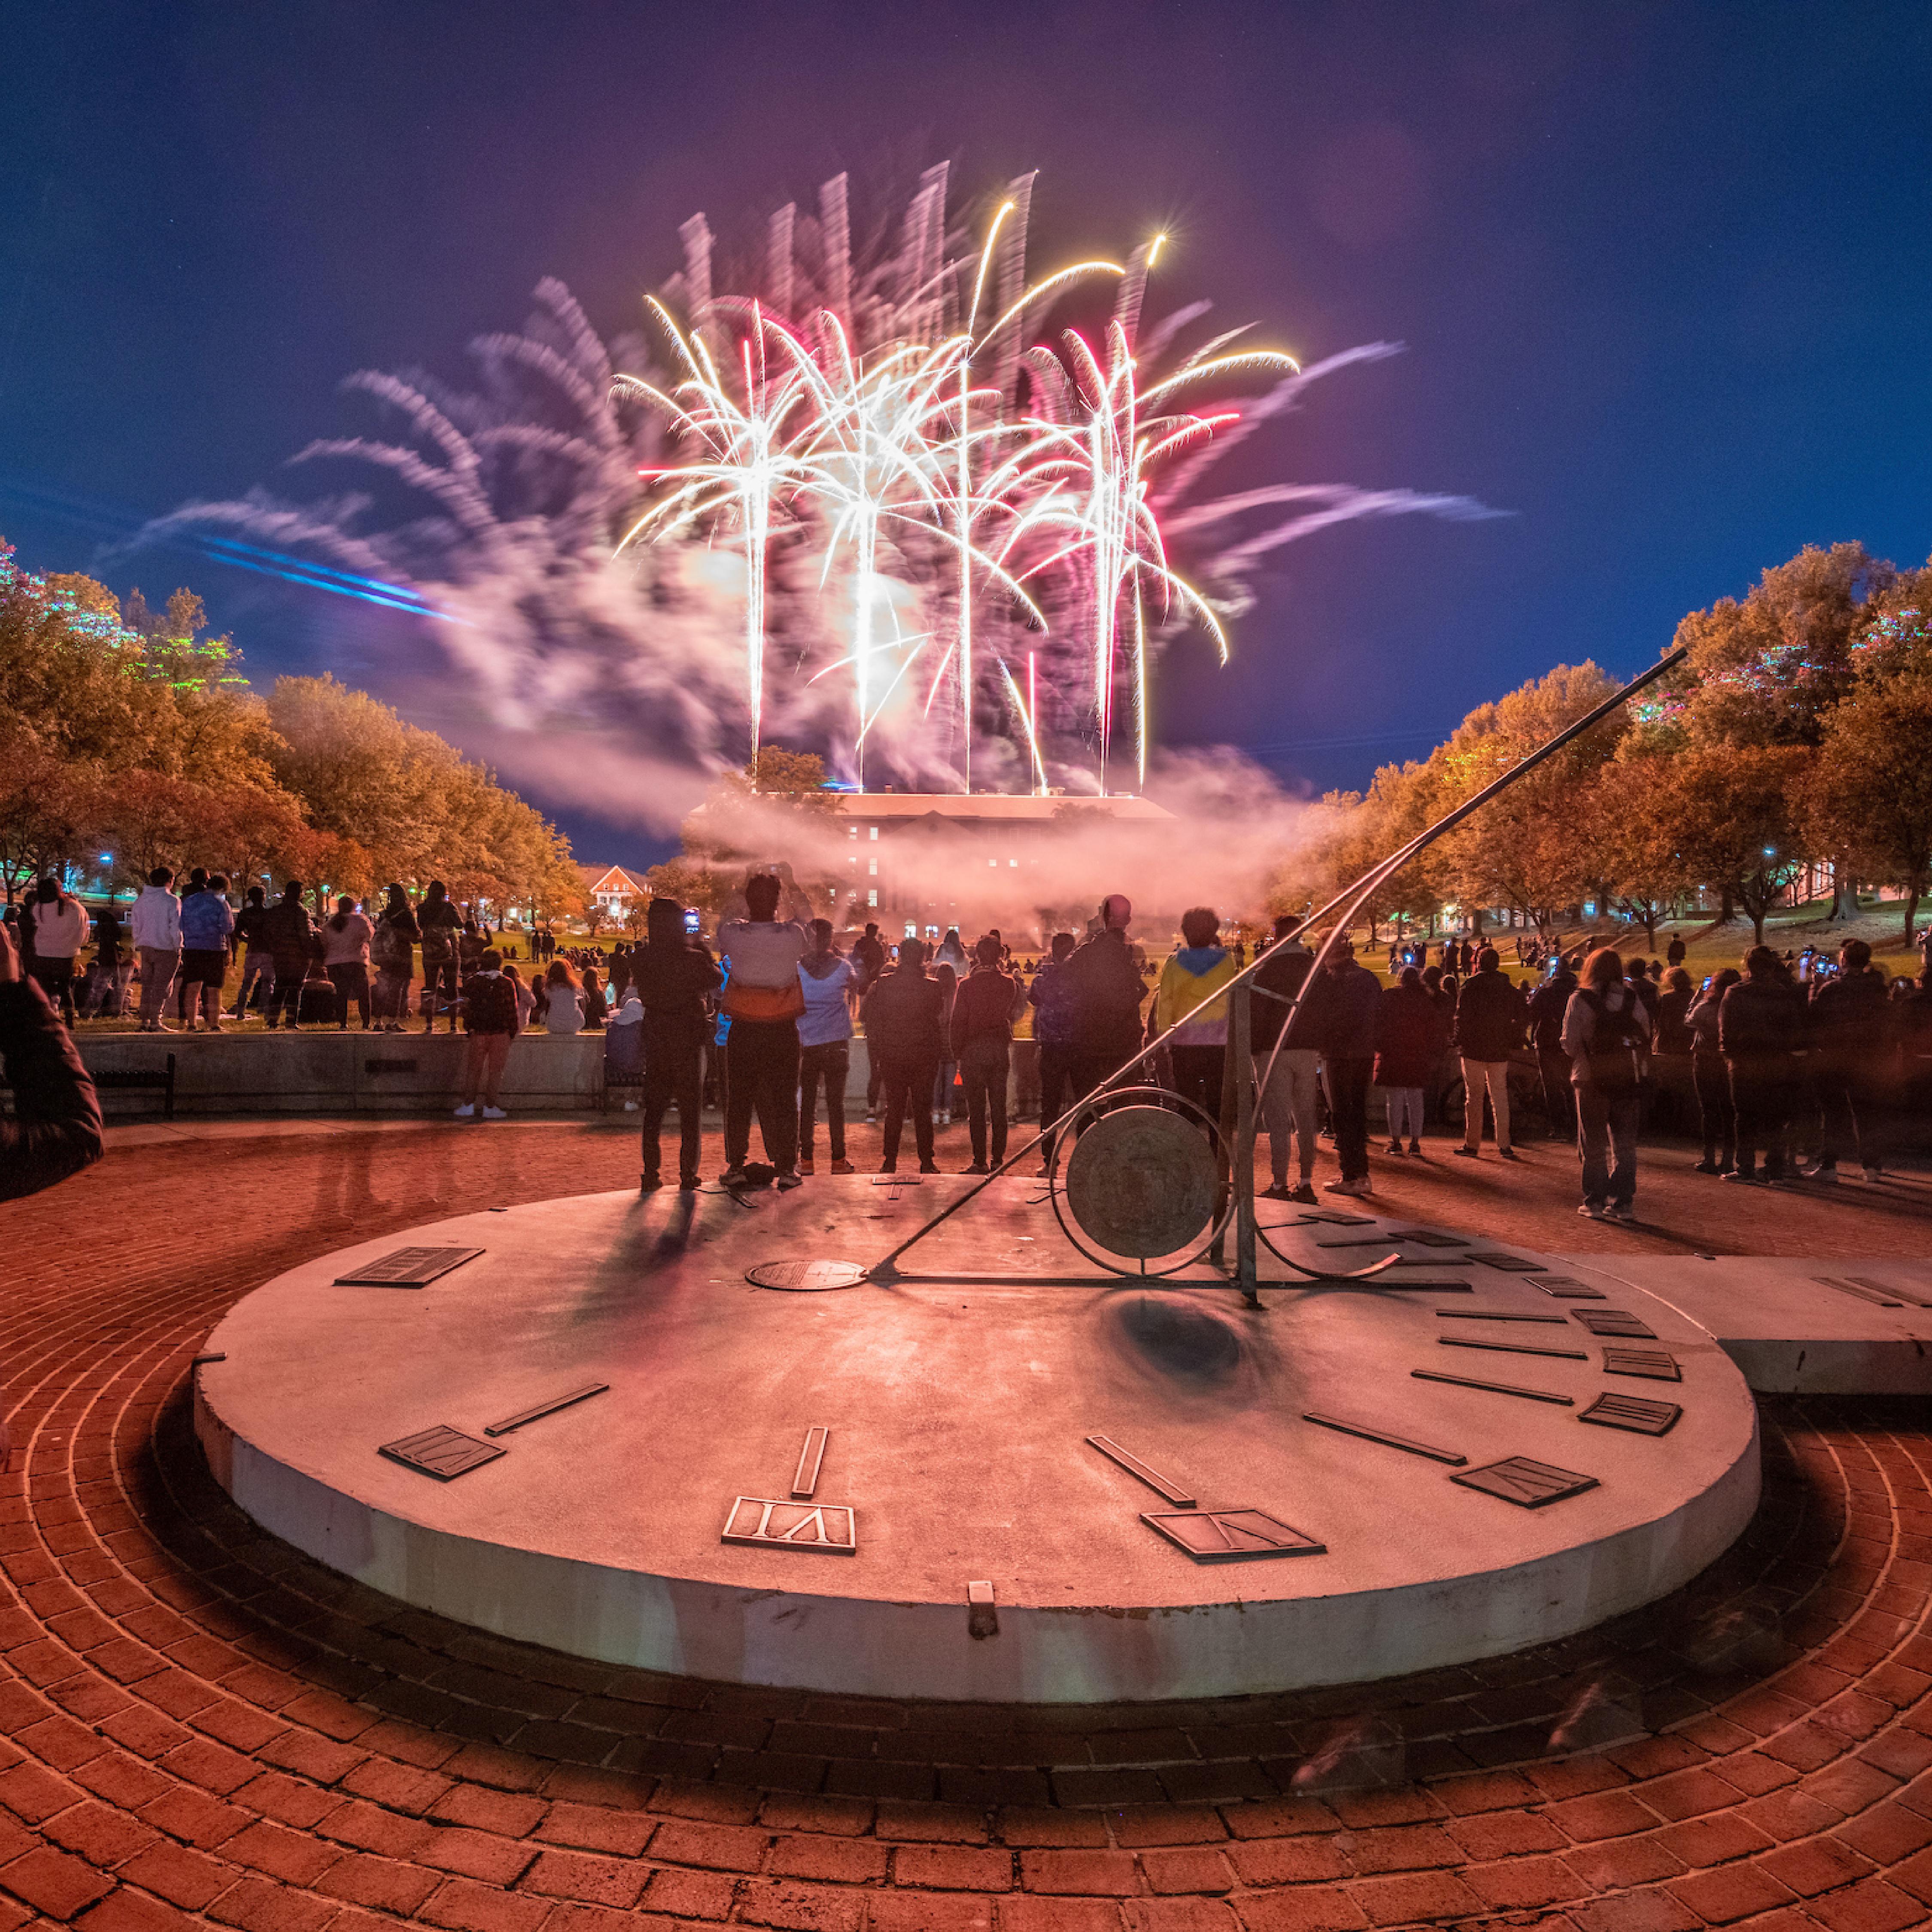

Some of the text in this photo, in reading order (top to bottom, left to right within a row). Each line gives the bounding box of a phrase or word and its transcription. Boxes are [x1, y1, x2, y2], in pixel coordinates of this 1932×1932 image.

[1610, 1355, 1672, 1368] II
[1592, 1402, 1671, 1425] III
[390, 1432, 487, 1472] VII
[1486, 1463, 1580, 1499] IV
[752, 1504, 829, 1542] VI
[1206, 1513, 1295, 1549] V
